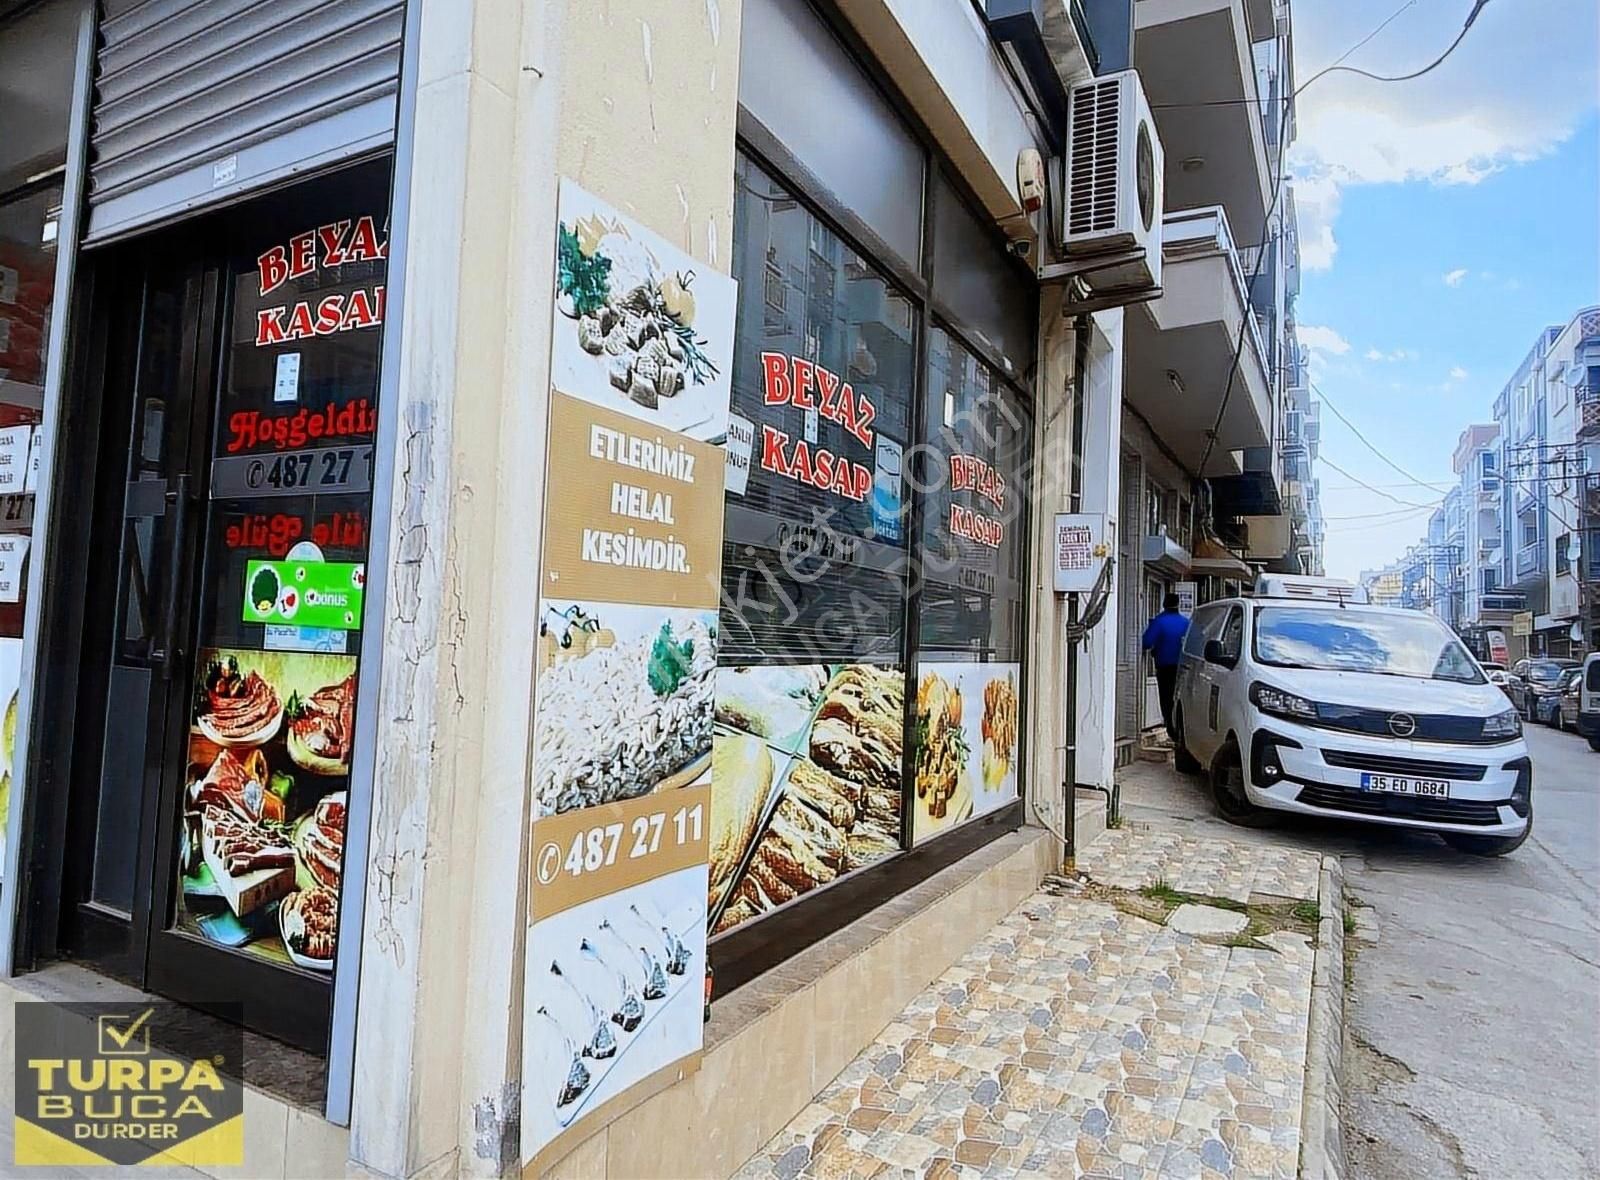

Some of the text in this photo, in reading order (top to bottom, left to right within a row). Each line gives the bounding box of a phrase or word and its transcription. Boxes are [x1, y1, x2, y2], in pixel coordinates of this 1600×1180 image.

[761, 351, 876, 449] BEYAZ
[267, 454, 314, 489] 487
[320, 450, 355, 484] 27
[590, 424, 695, 484] ETLERİMİZ
[761, 424, 872, 502] KASAP
[611, 482, 675, 525] HELAL
[950, 453, 1005, 512] BEYAZ
[582, 528, 691, 574] KESİMDİR.
[950, 503, 1004, 549] KASAP
[1371, 776, 1386, 790] 35
[1414, 781, 1445, 796] 0684
[564, 804, 703, 876] 487 27 11
